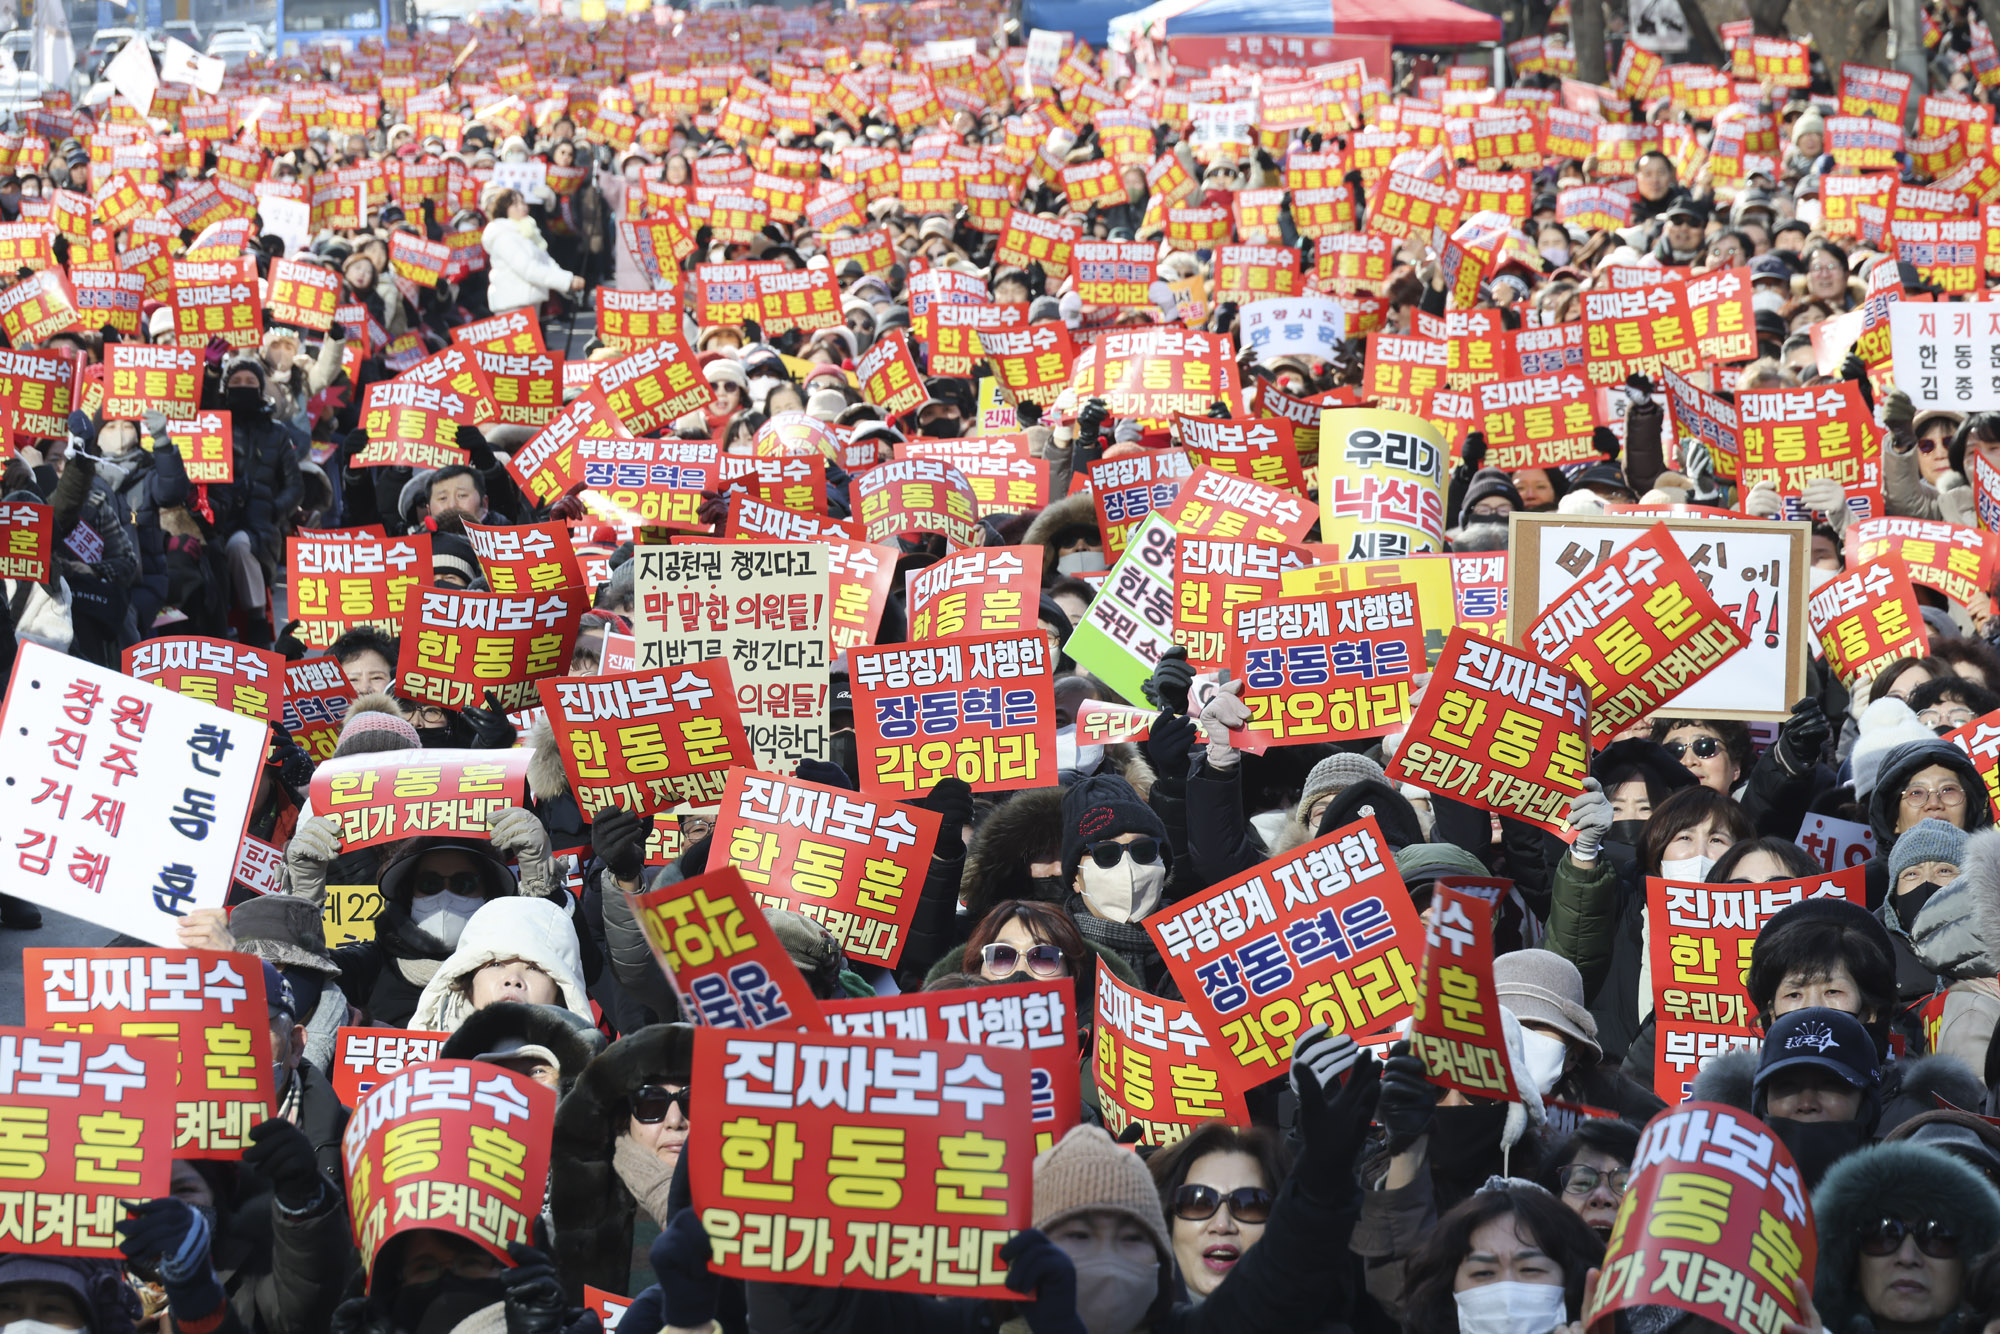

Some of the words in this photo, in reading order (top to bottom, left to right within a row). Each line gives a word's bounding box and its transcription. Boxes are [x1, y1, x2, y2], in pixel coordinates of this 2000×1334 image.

[1389, 172, 1460, 207] 진짜보수
[1222, 246, 1293, 266] 진짜보수
[1318, 234, 1385, 254] 진짜보수
[174, 262, 237, 281] 진짜보수
[277, 261, 338, 290] 진짜보수
[759, 270, 828, 293] 진짜보수
[177, 284, 251, 307] 진짜보수
[603, 290, 676, 312] 진짜보수
[1586, 287, 1675, 320] 진짜보수
[456, 312, 529, 344] 진짜보수
[937, 305, 1021, 327] 진짜보수
[113, 346, 196, 370] 진짜보수
[979, 327, 1057, 354] 진짜보수
[1105, 332, 1210, 359] 진짜보수
[598, 340, 679, 393] 진짜보수
[931, 356, 971, 374] 우리가
[1374, 364, 1438, 395] 한동
[1588, 361, 1626, 384] 우리가
[107, 399, 147, 419] 우리가
[371, 383, 464, 416] 진짜보수
[655, 384, 711, 423] 지켜낸다
[1151, 393, 1215, 416] 지켜낸다
[1480, 374, 1585, 410] 진짜보수
[1740, 388, 1846, 423] 진짜보수
[356, 442, 398, 464] 우리가
[513, 400, 596, 480] 진짜보수
[578, 439, 654, 461] 부당징계
[660, 442, 718, 463] 자행한
[1179, 416, 1278, 453] 진짜보수
[1092, 459, 1152, 490] 부당징계
[1345, 429, 1442, 488] 우리가
[1484, 444, 1534, 469] 우리가
[585, 462, 706, 489] 장동혁은
[858, 460, 969, 495] 진짜보수
[1194, 471, 1302, 526] 진짜보수
[913, 512, 978, 548] 지켜낸다
[1858, 519, 1983, 549] 진짜보수
[297, 542, 417, 574] 진짜보수
[731, 551, 817, 581] 챙긴다고
[914, 551, 1024, 610] 진짜보수
[1117, 567, 1175, 626] 한동
[1809, 563, 1894, 627] 진짜보수
[421, 592, 568, 631] 진짜보수
[735, 593, 823, 631] 의원들!
[1094, 600, 1138, 645] 국민
[1237, 602, 1330, 643] 부당징계
[1335, 591, 1414, 634] 자행한
[1530, 546, 1665, 662] 진짜보수
[131, 640, 270, 680] 진짜보수
[732, 639, 824, 670] 챙긴다고
[856, 646, 962, 691] 부당징계
[970, 637, 1045, 679] 자행한
[1174, 629, 1226, 663] 우리가
[1246, 640, 1410, 689] 장동혁은
[286, 661, 345, 693] 자행한
[402, 671, 476, 706] 우리가
[1453, 639, 1587, 727] 진짜보수
[1592, 687, 1658, 737] 우리가
[1641, 619, 1740, 704] 지켜낸다
[62, 677, 154, 743] 창원
[555, 670, 714, 722] 진짜보수
[738, 684, 828, 718] 의원들!
[875, 687, 1038, 739] 장동혁은
[1244, 681, 1412, 739] 각오하라
[48, 727, 140, 788] 진주
[875, 733, 1040, 791] 각오하라
[1400, 742, 1480, 795] 우리가
[30, 777, 127, 838] 거제
[738, 776, 917, 853] 진짜보수
[15, 828, 111, 893] 김해
[1157, 877, 1278, 962] 부당징계
[1272, 829, 1385, 909] 자행한
[1196, 897, 1396, 1015] 장동혁은
[43, 956, 247, 1013] 진짜보수
[940, 990, 1065, 1050] 자행한
[1098, 966, 1211, 1056] 진짜보수
[1219, 946, 1418, 1069] 각오하라
[1664, 989, 1748, 1025] 우리가
[724, 1040, 1004, 1120] 진짜보수
[346, 1066, 530, 1165] 진짜보수
[393, 1181, 527, 1246] 지켜낸다
[701, 1208, 833, 1271] 우리가
